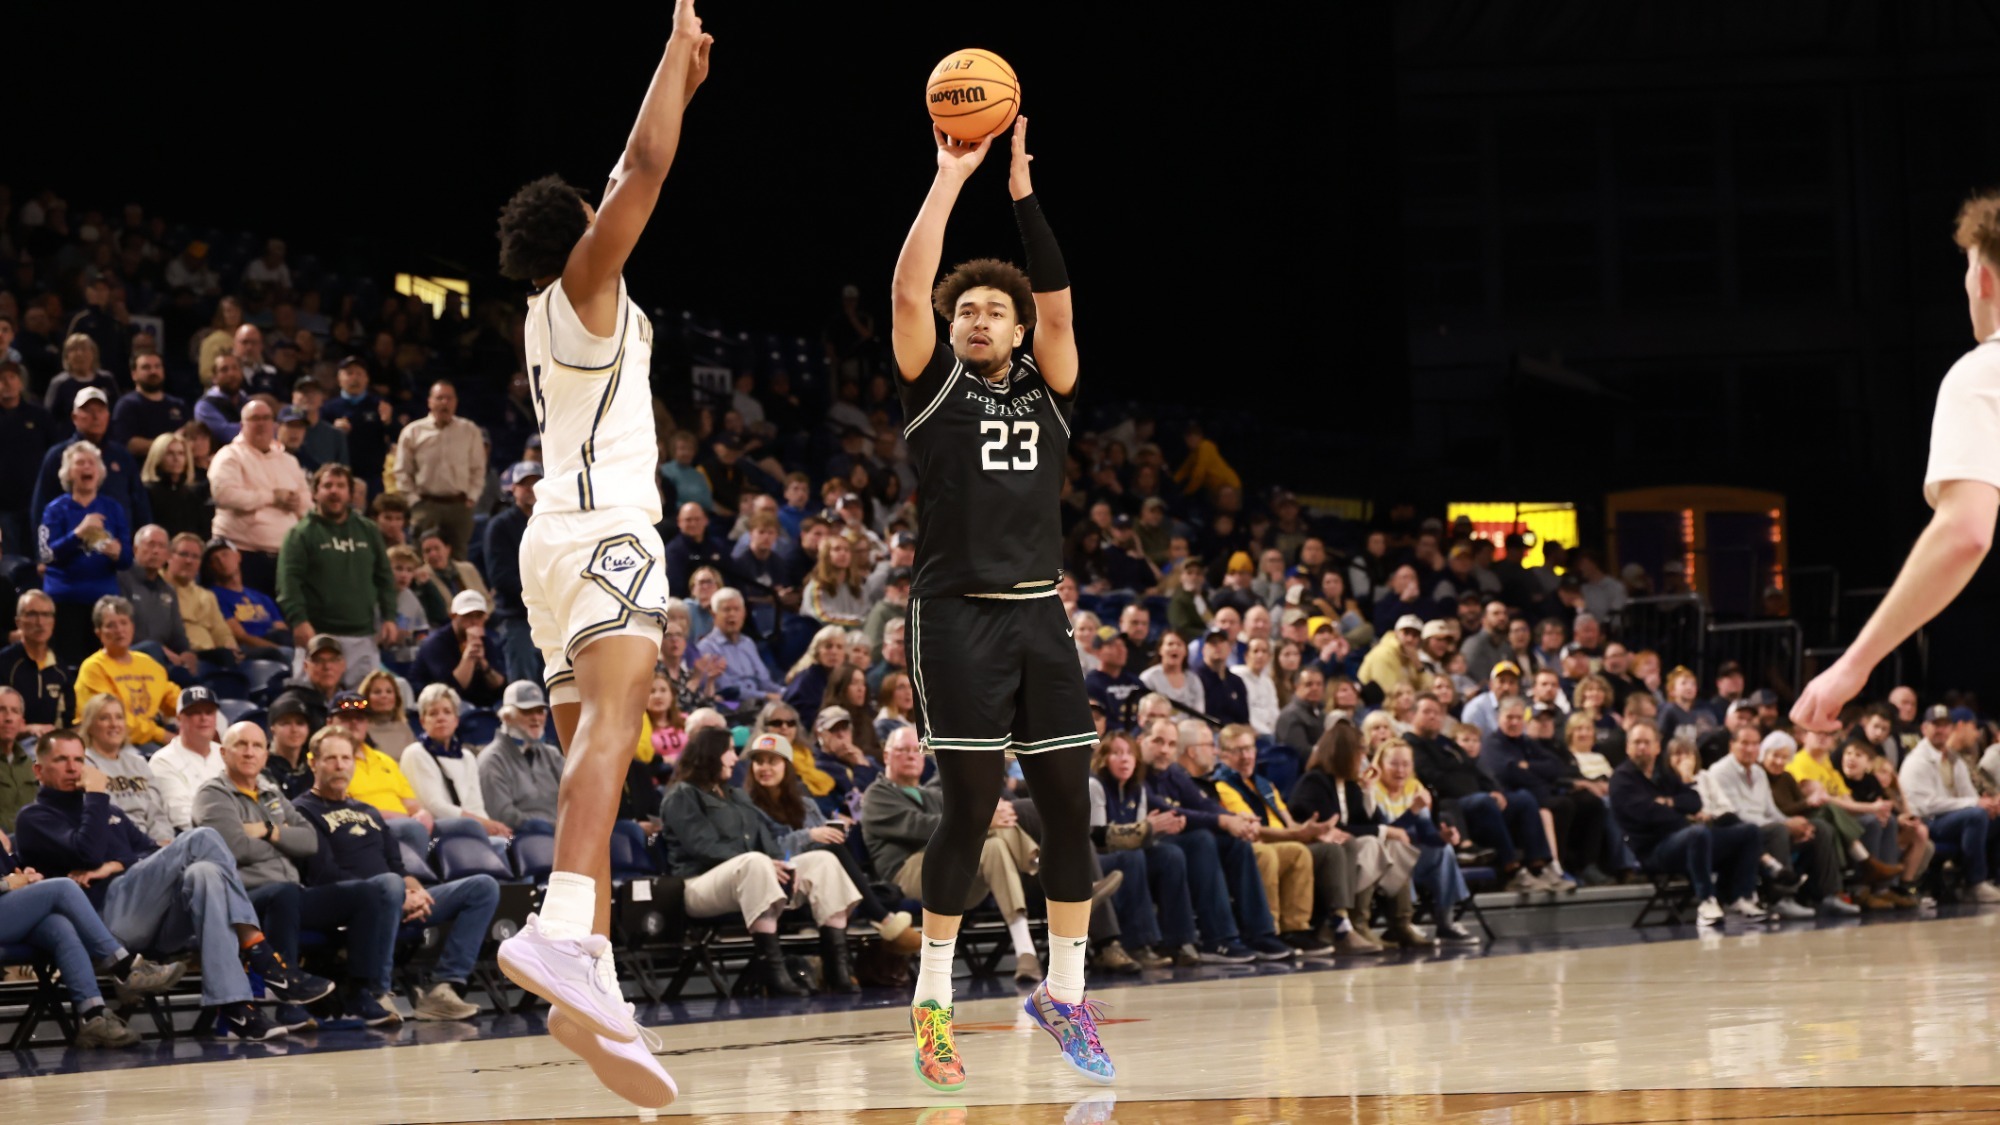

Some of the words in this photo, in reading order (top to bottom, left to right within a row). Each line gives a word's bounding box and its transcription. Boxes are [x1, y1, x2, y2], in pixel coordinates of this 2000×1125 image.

[930, 86, 987, 106] Wilson
[965, 388, 1042, 408] PORAND
[980, 420, 1040, 471] 23
